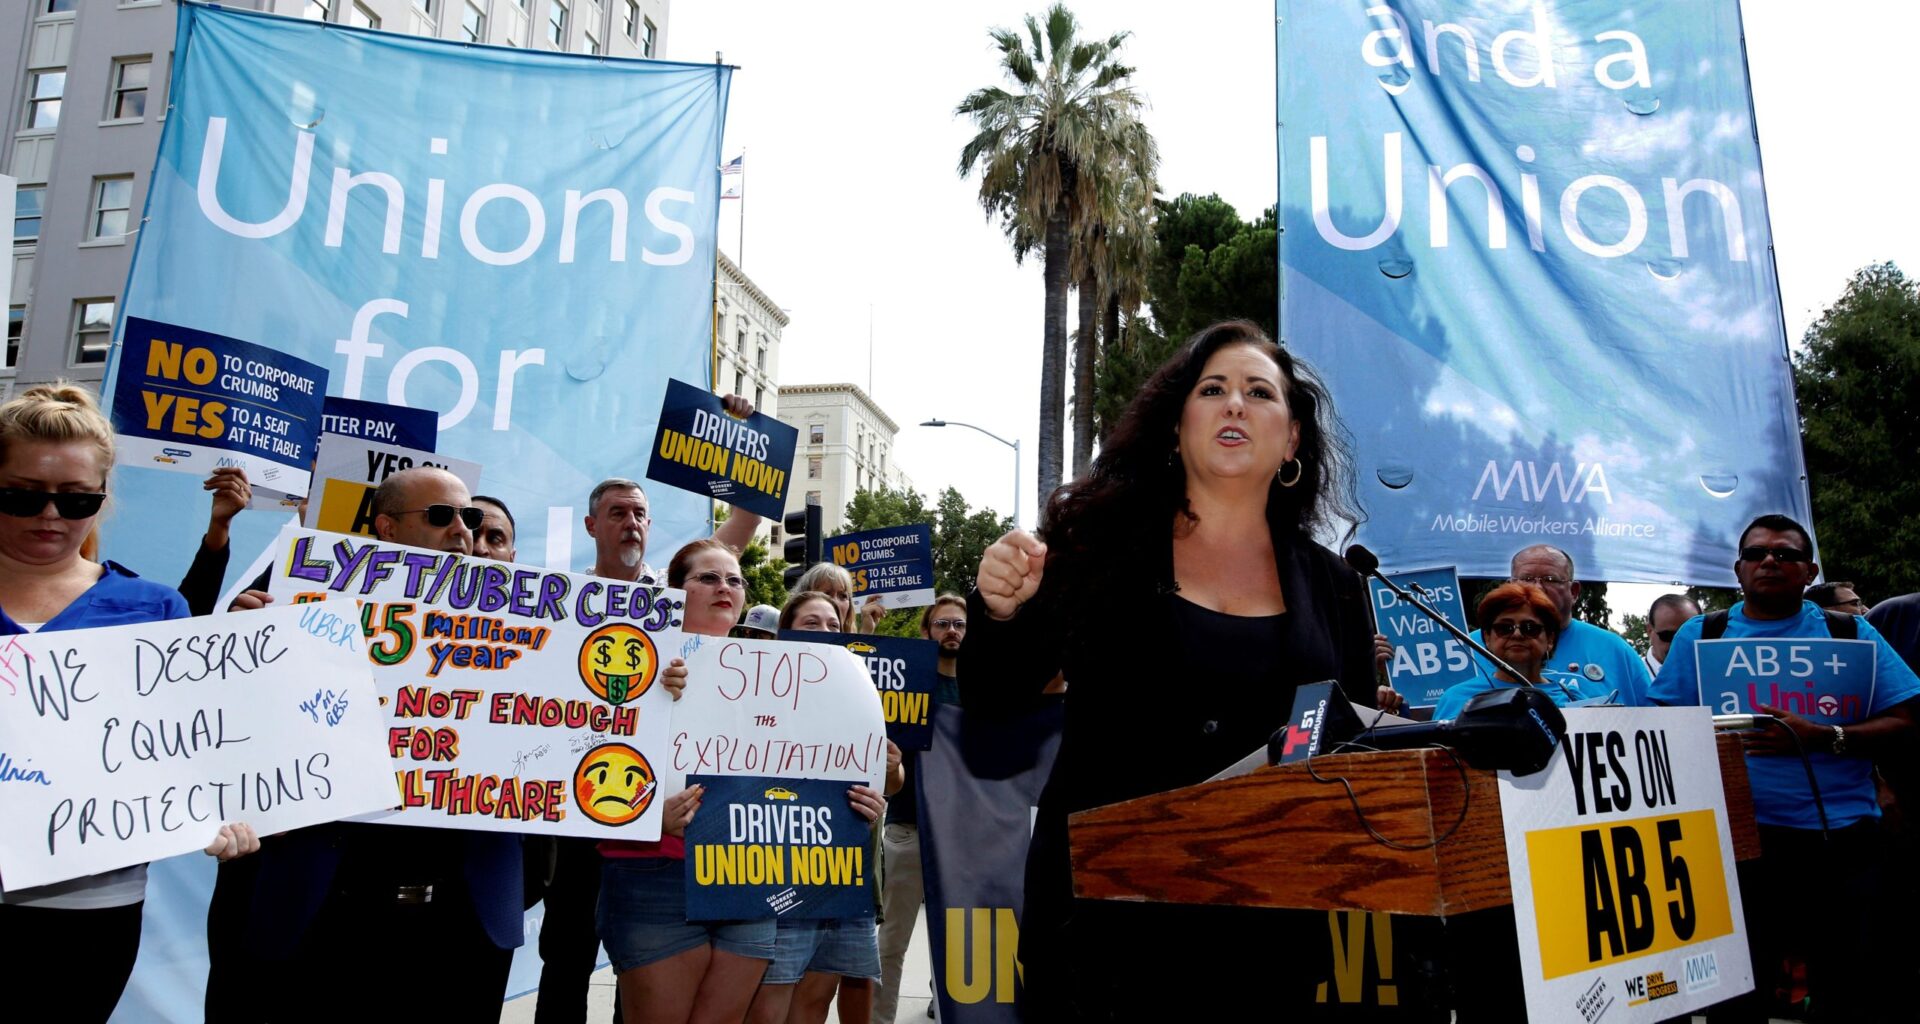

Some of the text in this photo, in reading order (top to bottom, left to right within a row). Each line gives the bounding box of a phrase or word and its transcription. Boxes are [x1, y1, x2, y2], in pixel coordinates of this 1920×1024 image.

[1362, 0, 1651, 89] and a
[199, 116, 696, 266] Unions
[1310, 133, 1748, 261] Union
[145, 338, 315, 395] NO TO CORPORATE
[336, 299, 545, 431] for
[220, 374, 280, 402] CRUMBS
[142, 390, 290, 439] YES TO A SEAT
[321, 414, 398, 442] TTER PAY,
[691, 408, 770, 462] DRIVERS
[228, 427, 246, 443] AT
[248, 430, 270, 450] THE
[272, 436, 302, 460] TABLE
[659, 428, 785, 499] UNION NOW!
[1472, 460, 1613, 504] MWA
[1431, 514, 1656, 538] Mobile Workers Alliance
[833, 534, 920, 566] NO TO CORPORATE
[861, 548, 895, 562] CRUMBS
[288, 536, 572, 622] LYFT/UBER
[850, 565, 908, 593] ES TO A SEAT
[869, 575, 922, 590] AT THE TABLE
[299, 606, 357, 652] UBER
[24, 624, 289, 721] WE DESERVE
[426, 641, 522, 678] year
[717, 642, 828, 710] STOP
[394, 684, 639, 737] NOT ENOUGH
[753, 715, 777, 727] THE
[879, 690, 929, 726] OW!
[1301, 709, 1316, 728] 51
[1720, 691, 1740, 714] a
[101, 708, 251, 774] EQUAL
[388, 725, 460, 762] FOR
[673, 732, 884, 776] EXPLOITATION!
[1560, 729, 1676, 815] YES ON
[47, 752, 333, 856] PROTECTIONS
[395, 768, 566, 822] LTHCARE
[729, 803, 833, 845] DRIVERS
[694, 844, 864, 886] UNION NOW!
[1624, 975, 1645, 998] WE
[1686, 953, 1718, 983] MWA
